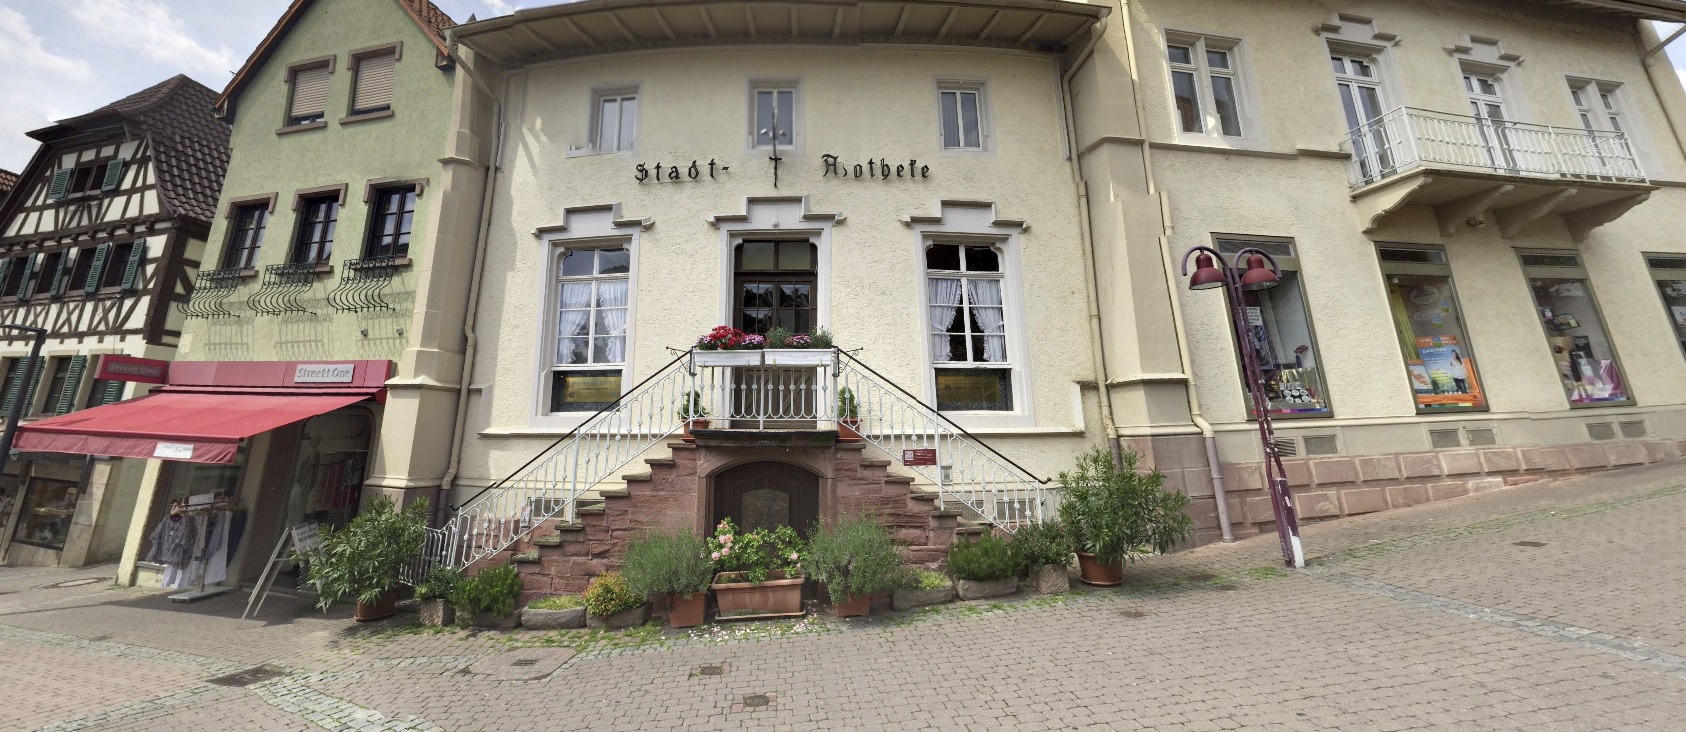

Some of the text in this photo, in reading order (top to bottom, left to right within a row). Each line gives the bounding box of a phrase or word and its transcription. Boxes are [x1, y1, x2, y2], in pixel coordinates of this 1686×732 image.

[635, 158, 730, 183] Stadt-
[110, 364, 159, 375] Street One
[332, 368, 350, 378] One
